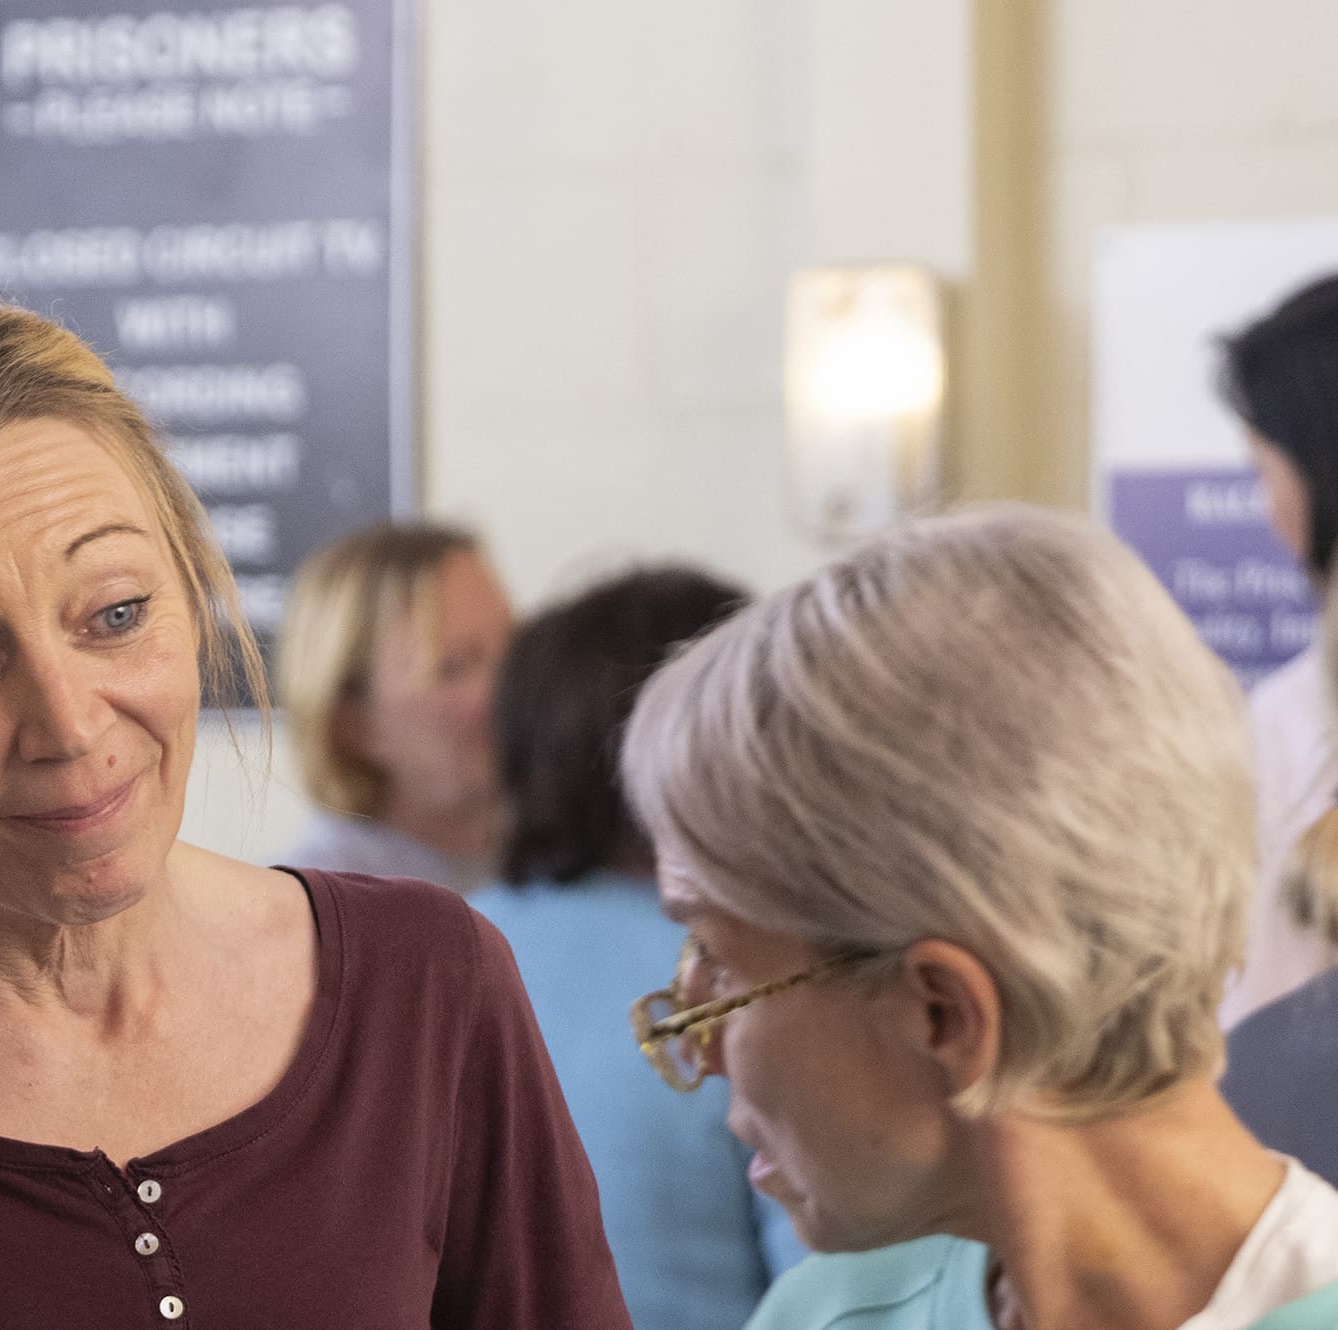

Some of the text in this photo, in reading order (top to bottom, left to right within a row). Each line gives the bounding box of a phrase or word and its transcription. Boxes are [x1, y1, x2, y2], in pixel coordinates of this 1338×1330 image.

[2, 10, 355, 84] PRISONERS
[35, 88, 196, 141] PLEASE
[204, 82, 317, 134] NOTE
[146, 224, 318, 281] CIRCUIT
[117, 298, 233, 346] WITH
